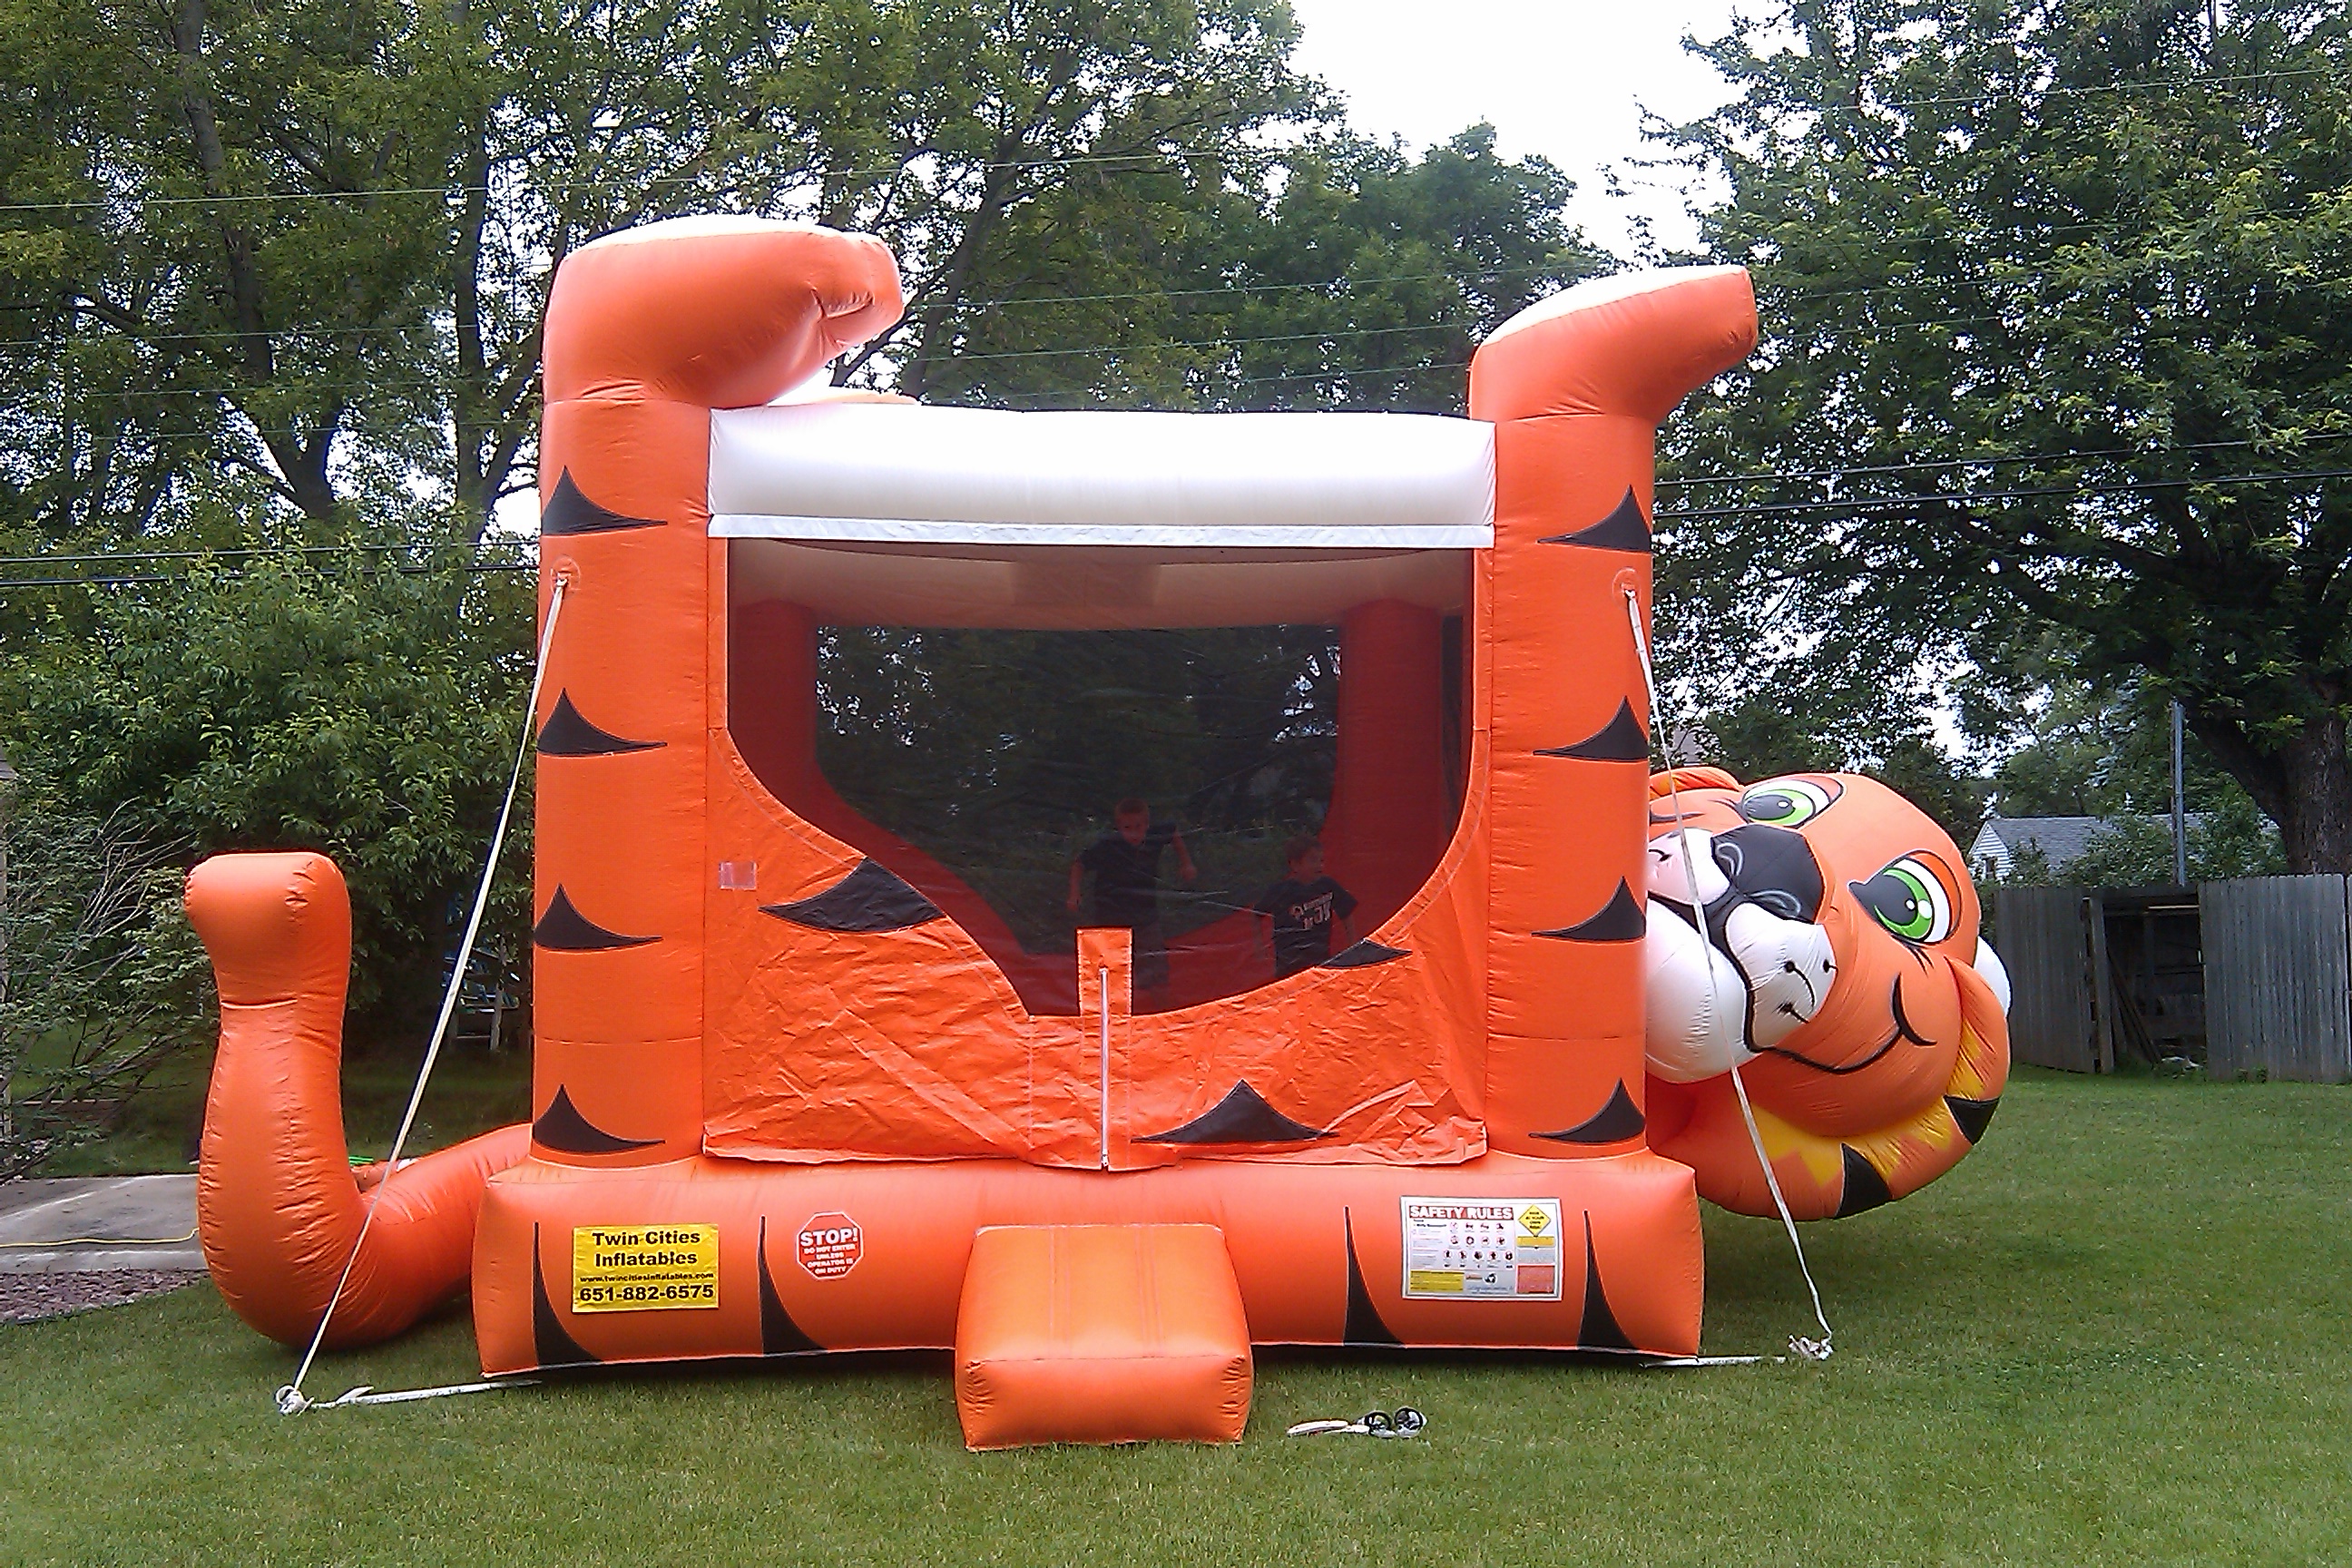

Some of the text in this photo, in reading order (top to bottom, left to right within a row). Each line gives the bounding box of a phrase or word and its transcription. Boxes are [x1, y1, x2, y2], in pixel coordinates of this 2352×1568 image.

[1409, 1205, 1513, 1220] SAFETY RULES
[593, 1230, 700, 1245] Twin Cities
[800, 1228, 858, 1247] STOP!
[595, 1251, 697, 1267] Inflatables
[580, 1273, 713, 1281] www.twincitiesinflatables.com
[580, 1285, 713, 1301] 651-882-6575
